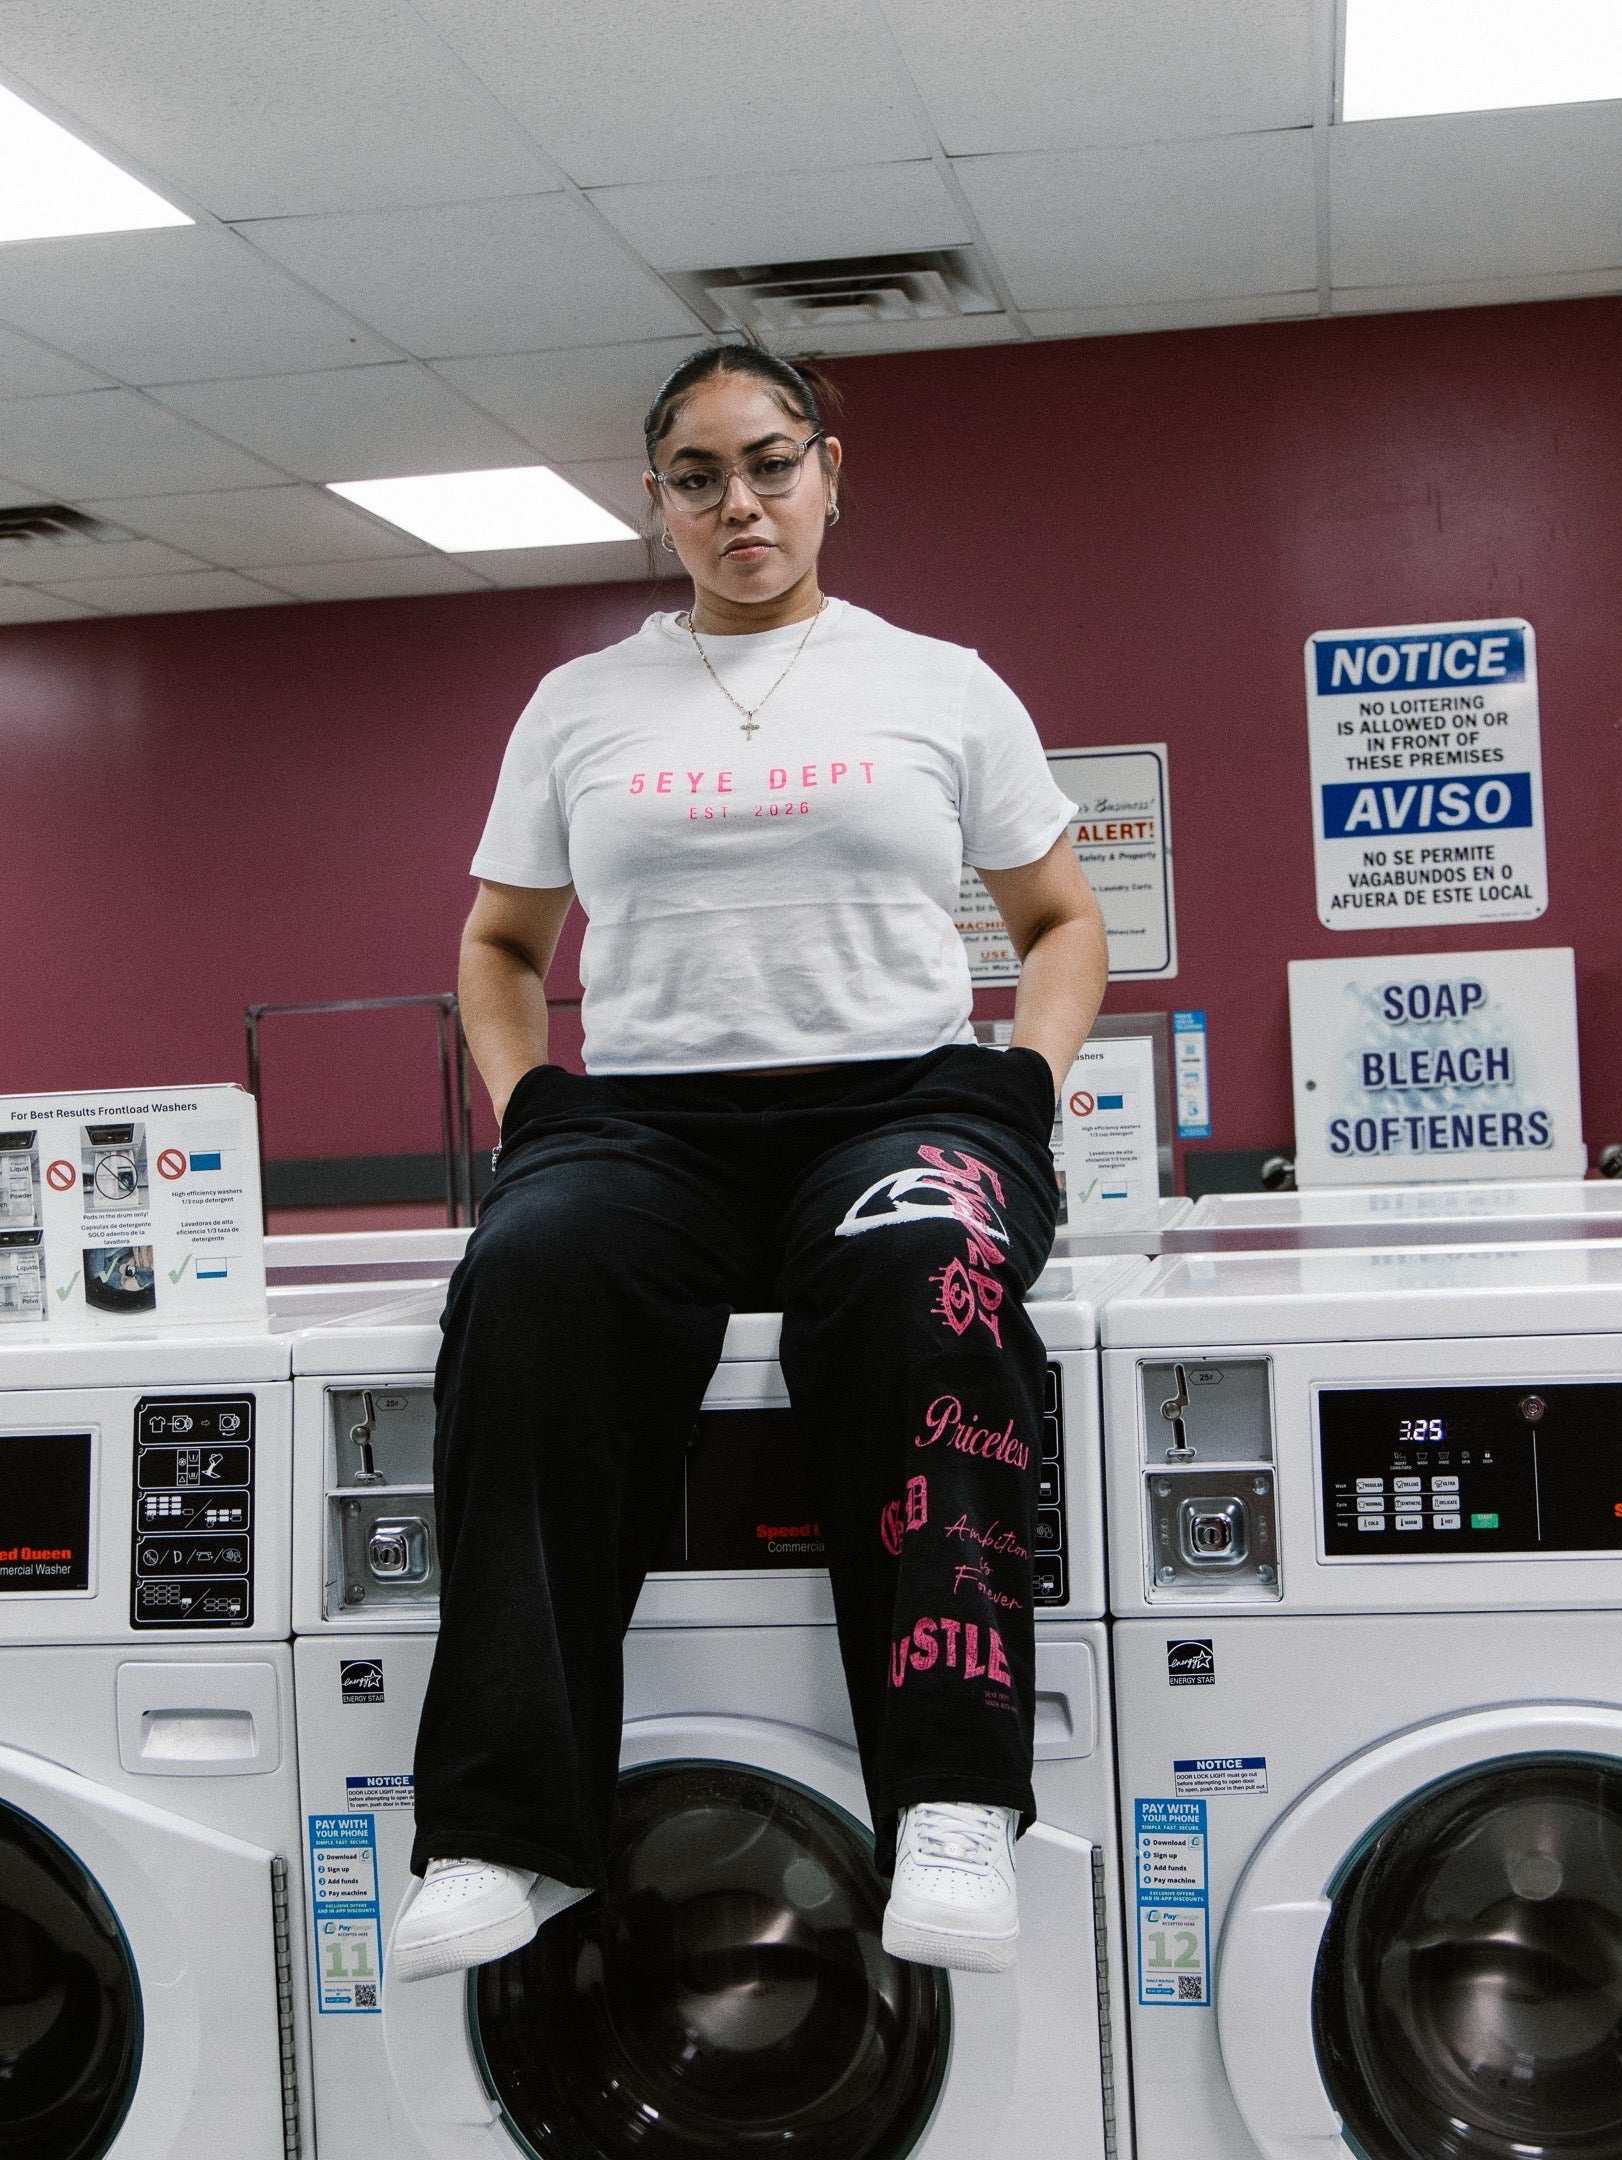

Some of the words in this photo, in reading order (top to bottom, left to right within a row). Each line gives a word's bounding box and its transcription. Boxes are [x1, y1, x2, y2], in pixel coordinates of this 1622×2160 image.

[1331, 637, 1509, 687] NOTICE
[1360, 702, 1384, 716] NO
[1391, 696, 1484, 715] LOITERING
[1338, 722, 1354, 735] IS
[1360, 716, 1446, 734] ALLOWED
[1453, 714, 1477, 728] ON
[1484, 712, 1508, 726] OR
[1368, 738, 1385, 751] IN
[1392, 734, 1449, 750] FRONT
[1457, 732, 1480, 746] OF
[1347, 754, 1403, 770] THESE
[1410, 748, 1504, 767] PREMISES
[769, 762, 874, 790] DEPT
[755, 801, 809, 816] 2026
[1344, 780, 1512, 831] AVISO
[1077, 822, 1154, 841] ALERT!
[1364, 852, 1386, 866] NO
[1394, 850, 1413, 864] SE
[1422, 846, 1495, 863] PERMITE
[1350, 870, 1466, 888] VAGABUNDOS
[1474, 868, 1494, 881] EN
[1502, 866, 1512, 879] O
[1332, 889, 1398, 909] AFUERA
[1405, 891, 1426, 905] DE
[1434, 888, 1472, 904] ESTE
[1480, 884, 1532, 901] LOCAL
[1384, 982, 1483, 1021] SOAP
[1074, 1053, 1104, 1061] ashers
[1362, 1047, 1510, 1086] BLEACH
[11, 1112, 27, 1121] For
[30, 1110, 54, 1120] Best
[57, 1108, 96, 1118] Results
[99, 1104, 149, 1116] Frontload
[152, 1103, 198, 1113] Washers
[1330, 1111, 1549, 1154] SOFTENERS
[915, 1395, 1029, 1470] Priceless
[1400, 1419, 1442, 1441] 3.25
[768, 1541, 825, 1553] Commercia
[945, 1513, 1029, 1560] Ambition
[22, 1547, 71, 1560] Queen
[36, 1564, 71, 1575] Washer
[980, 1556, 993, 1575] is
[953, 1565, 1023, 1609] Forever
[888, 1616, 1011, 1688] USTLE
[1196, 1760, 1243, 1770] NOTICE
[367, 1776, 410, 1786] NOTICE
[1142, 1804, 1164, 1813] PAY
[1167, 1804, 1199, 1814] WITH
[316, 1820, 336, 1829] PAY
[338, 1819, 367, 1829] WITH
[326, 1942, 374, 1977] 11
[1148, 1931, 1200, 1968] 12
